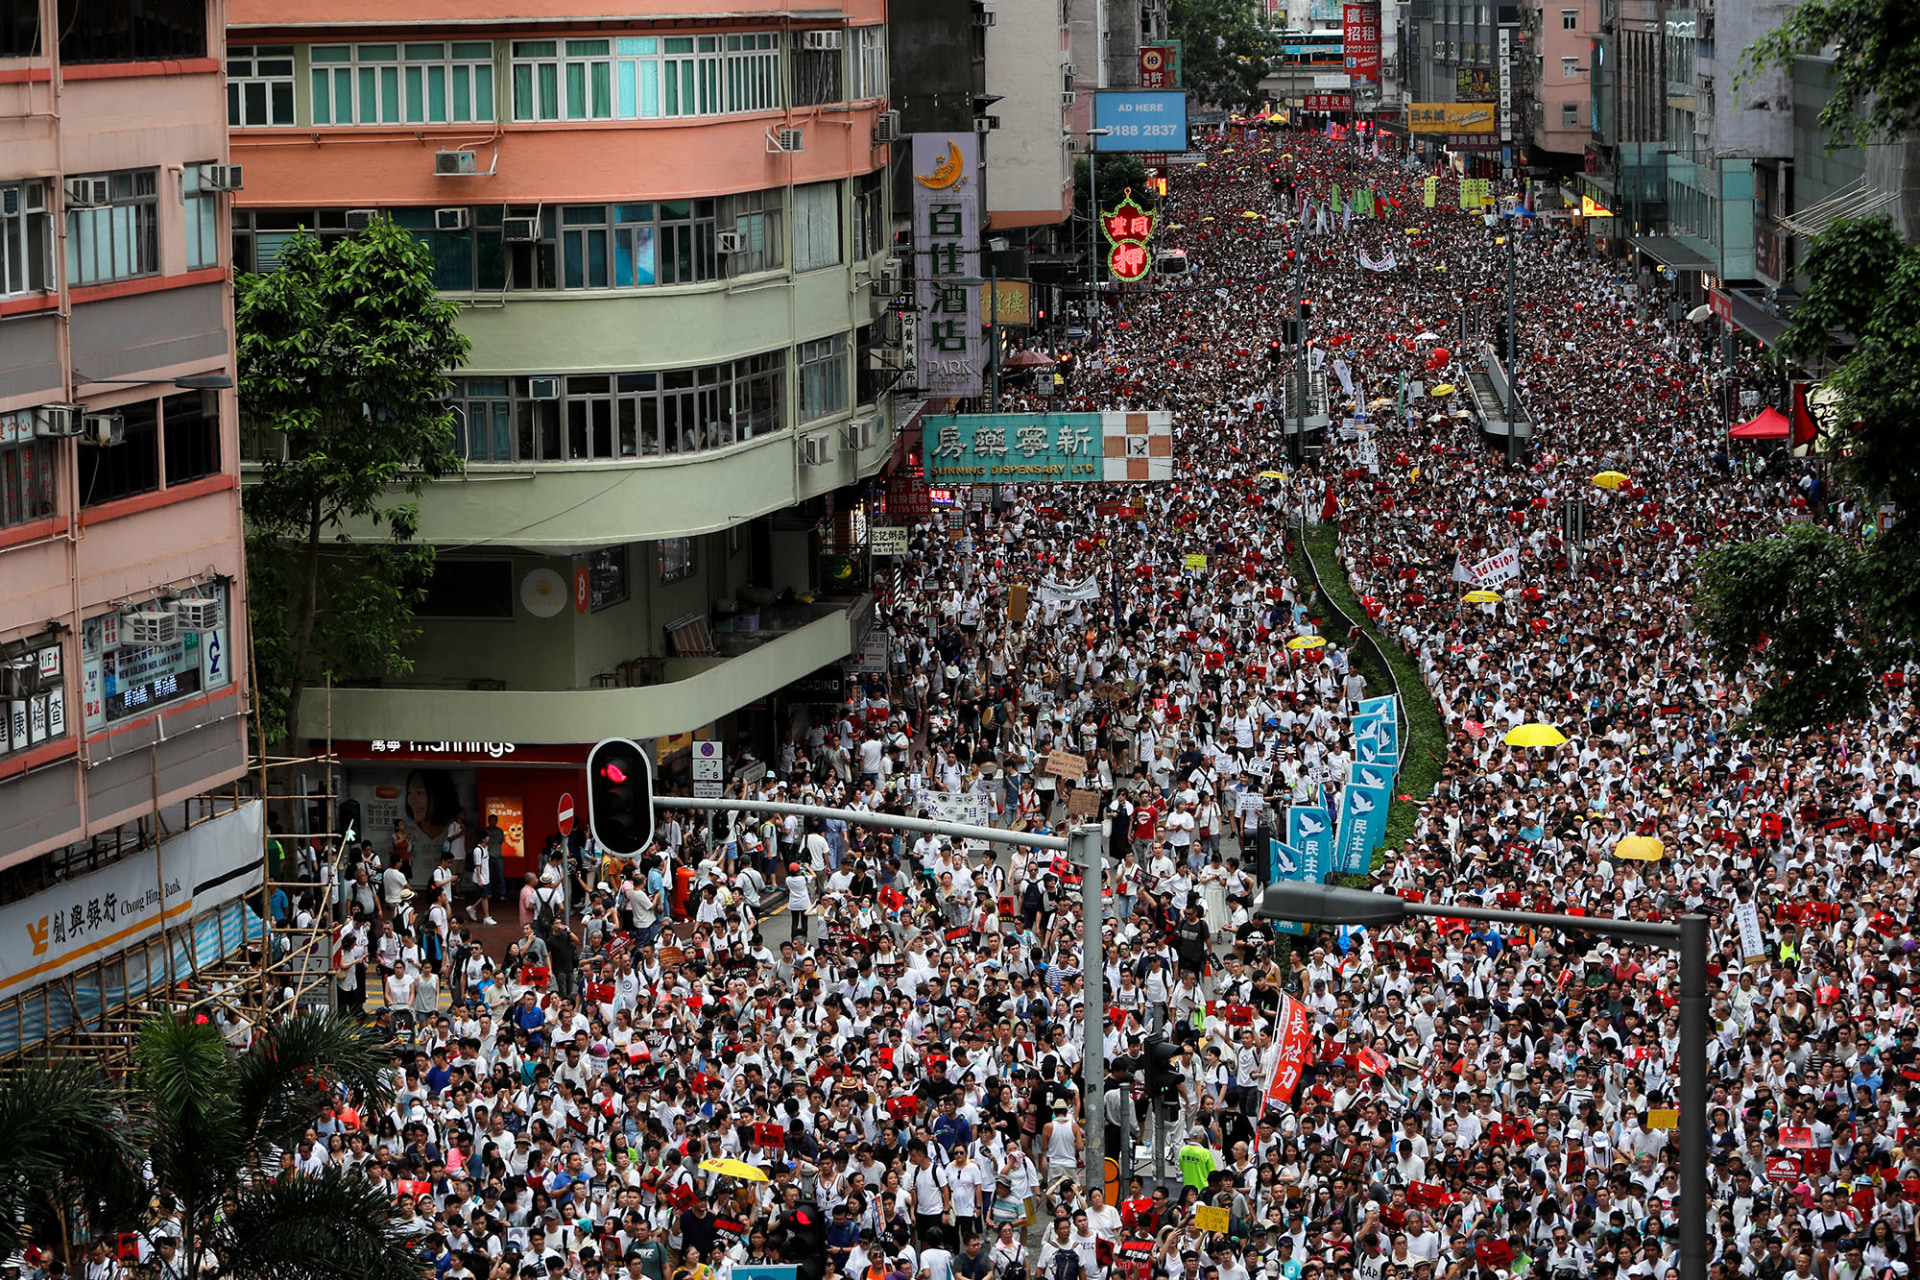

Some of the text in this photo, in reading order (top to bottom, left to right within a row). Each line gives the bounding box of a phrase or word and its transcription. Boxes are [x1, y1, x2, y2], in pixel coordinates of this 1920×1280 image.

[1347, 8, 1375, 23] 廣告
[1347, 26, 1376, 41] 招租
[1118, 104, 1132, 112] AD
[1106, 125, 1177, 136] 3188 2837
[1114, 245, 1144, 275] 押
[928, 203, 967, 350] 百佳酒店
[927, 360, 971, 375] PARK
[931, 466, 986, 476] SUNNING
[991, 464, 1066, 475] DISPENSARY
[1483, 571, 1509, 586] China
[41, 653, 51, 667] 1/F
[1350, 819, 1367, 869] 民主黨
[121, 878, 182, 916] Chong Hing Bank
[53, 892, 117, 943] 創興銀行
[316, 959, 323, 968] 7
[1362, 1265, 1378, 1279] GAP
